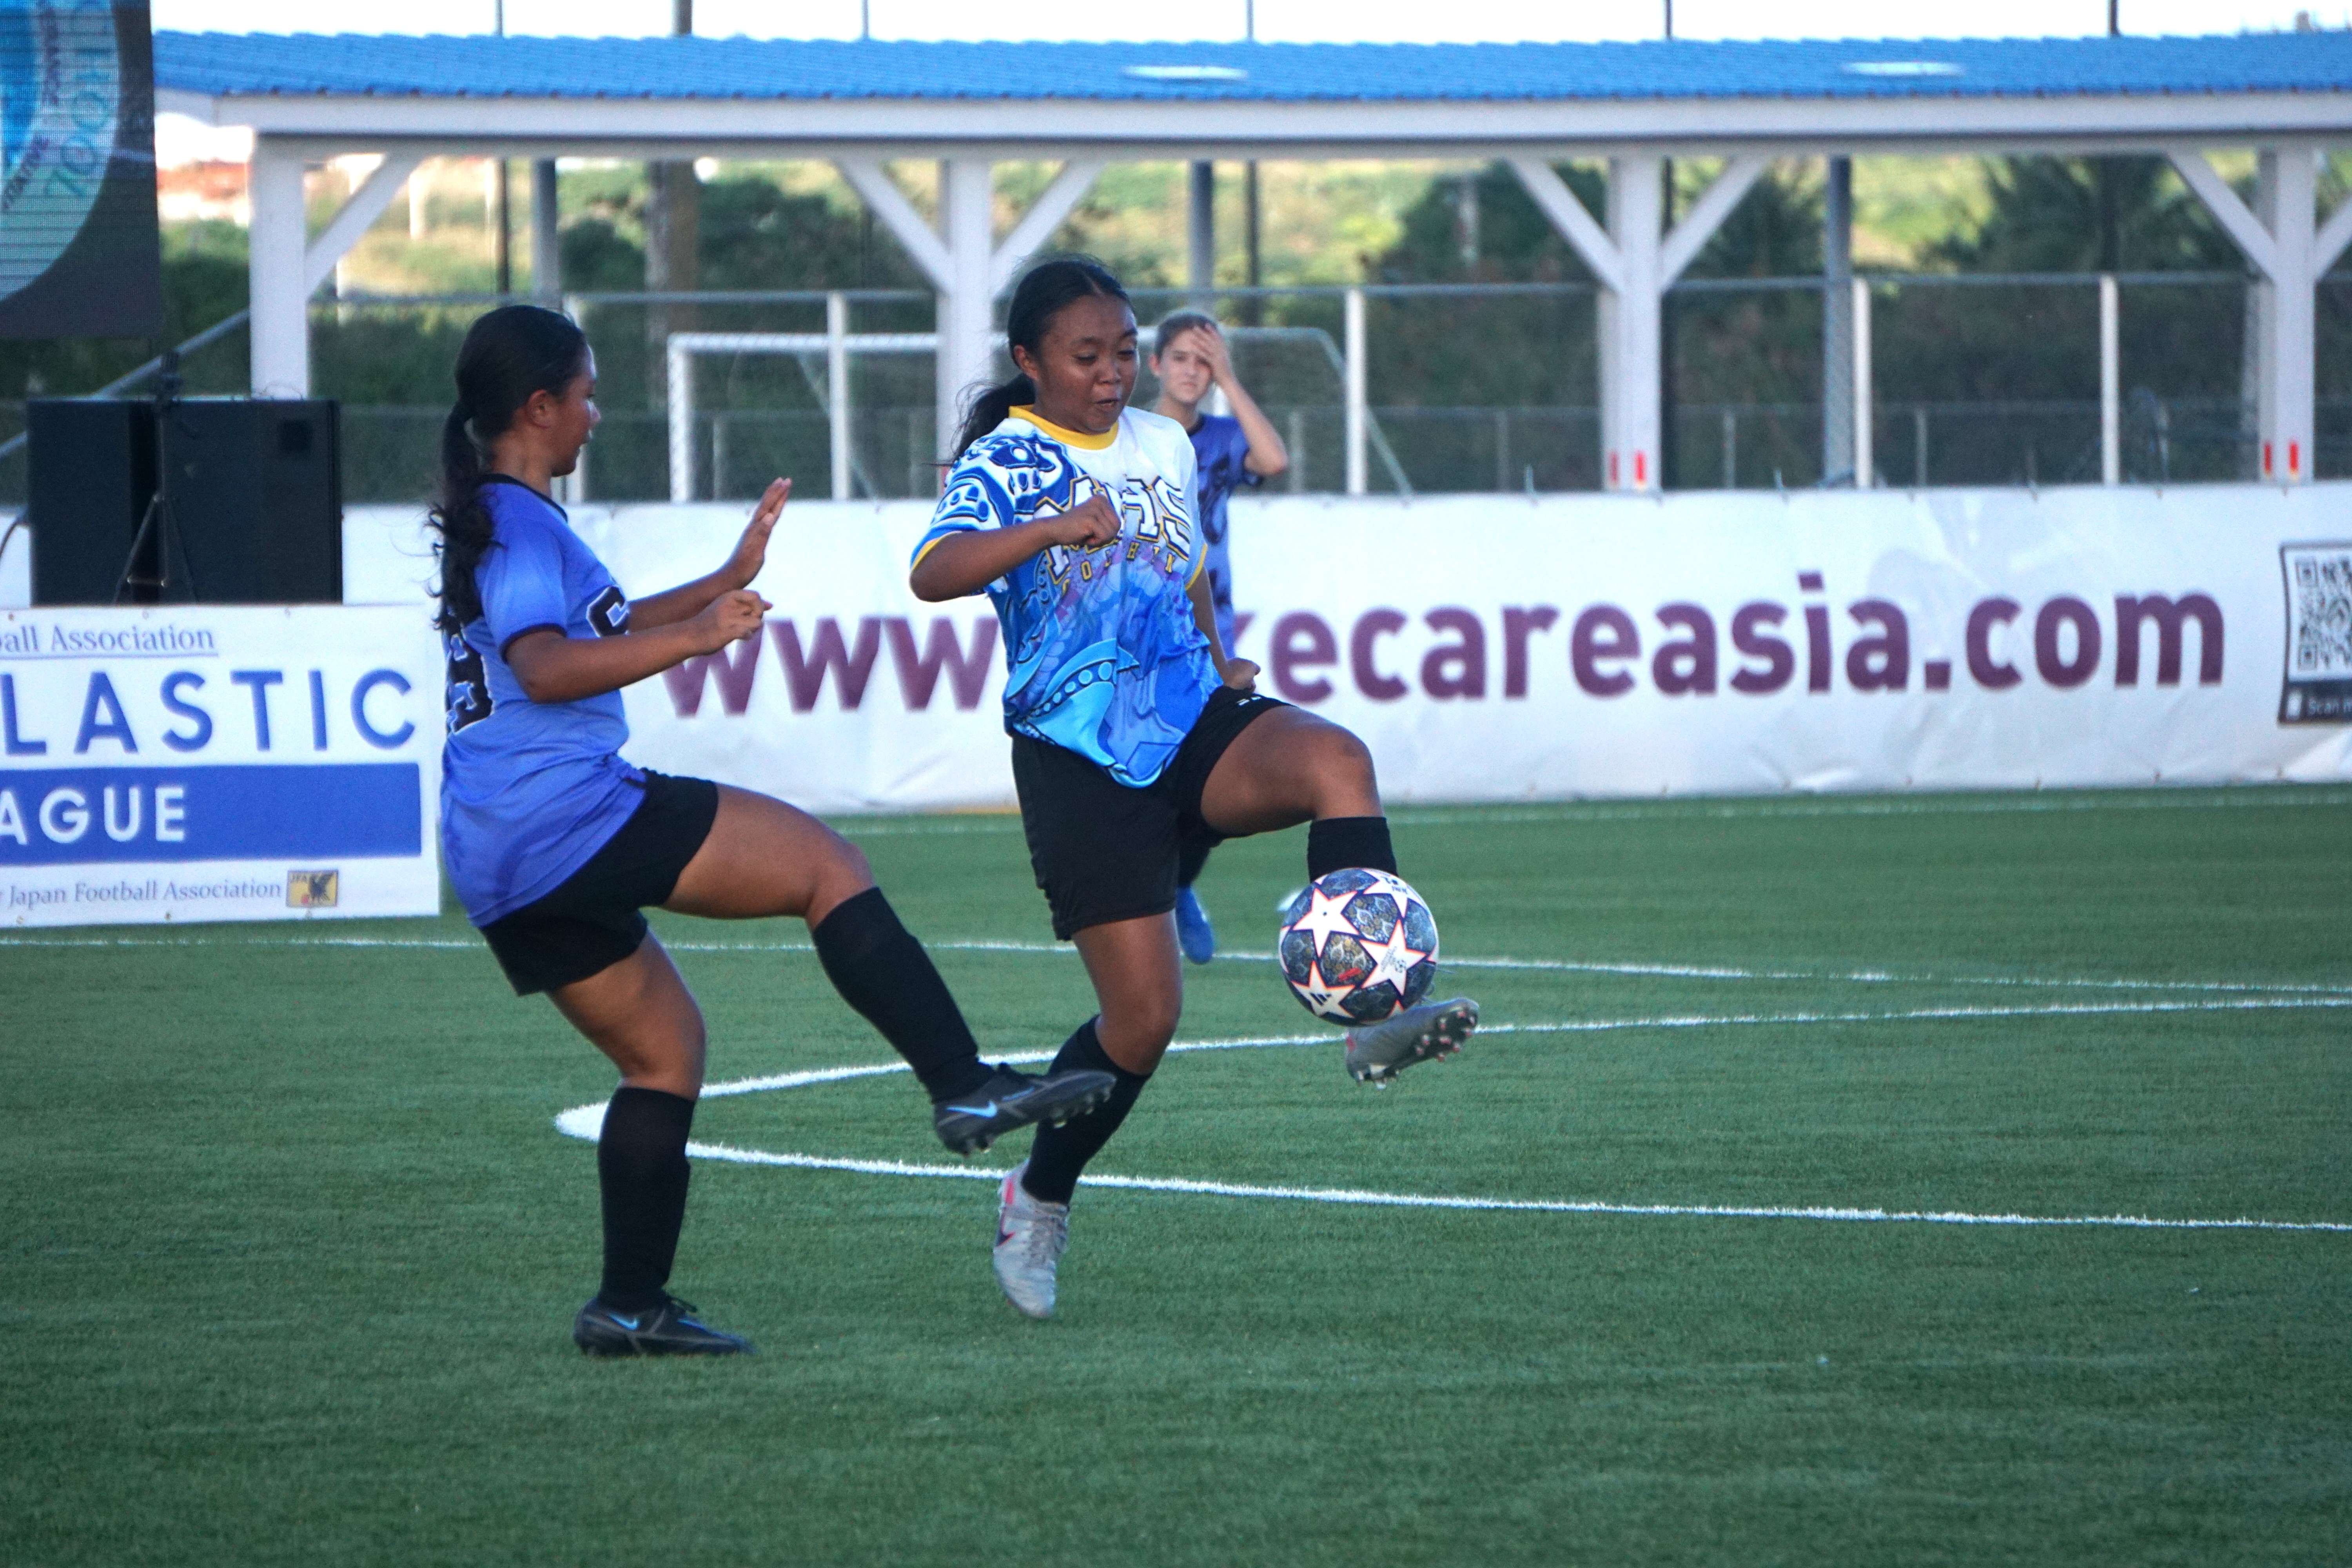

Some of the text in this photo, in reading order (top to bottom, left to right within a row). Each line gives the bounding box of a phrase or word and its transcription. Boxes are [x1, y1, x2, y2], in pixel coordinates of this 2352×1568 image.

[0, 623, 214, 652] all Association
[0, 668, 416, 755] LASTIC
[0, 786, 185, 845] AGUE
[7, 879, 281, 911] Japan Football Association
